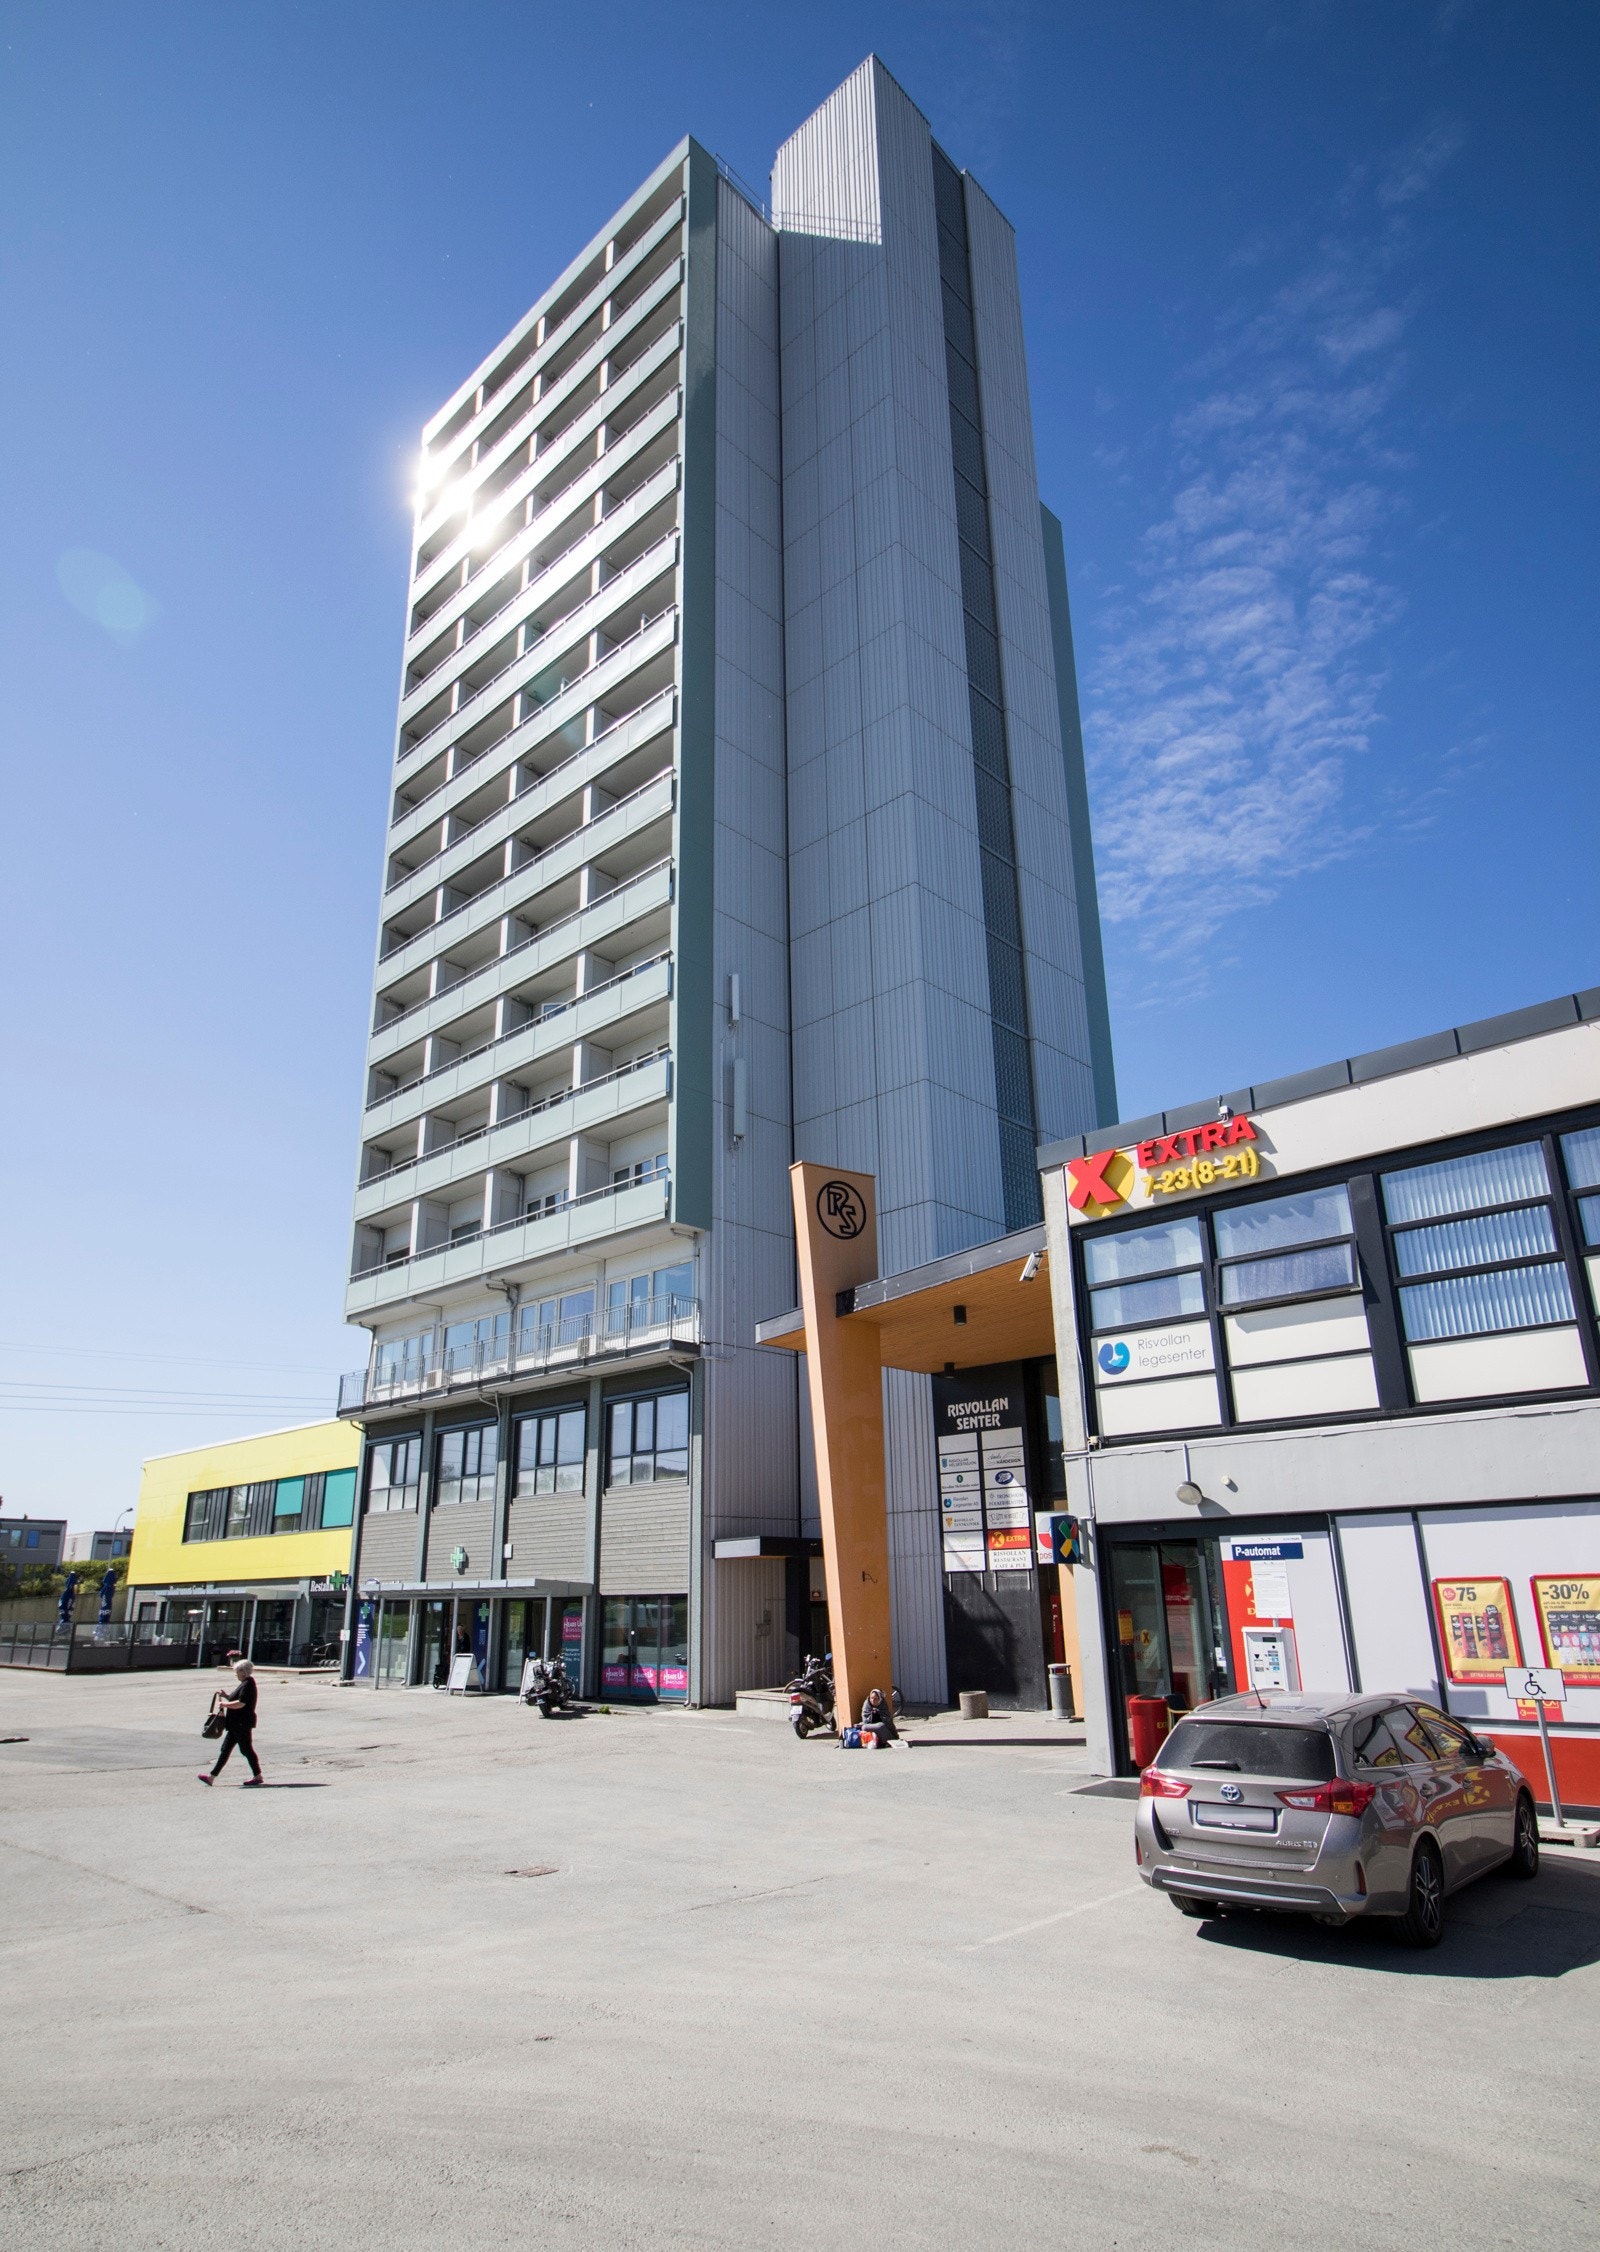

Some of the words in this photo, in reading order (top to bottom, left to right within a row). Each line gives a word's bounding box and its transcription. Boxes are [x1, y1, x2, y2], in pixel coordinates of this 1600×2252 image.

[1136, 1114, 1258, 1169] EXTRA
[1137, 1333, 1191, 1351] Risvollan
[1138, 1348, 1207, 1368] legesenter
[947, 1397, 1009, 1417] RISVOLLAN
[956, 1413, 1001, 1431] SENTER
[1005, 1535, 1028, 1543] EXTRA
[1039, 1552, 1053, 1561] pos
[1234, 1545, 1282, 1557] P-automat
[1456, 1587, 1478, 1602] 75
[1542, 1583, 1590, 1600] -30%
